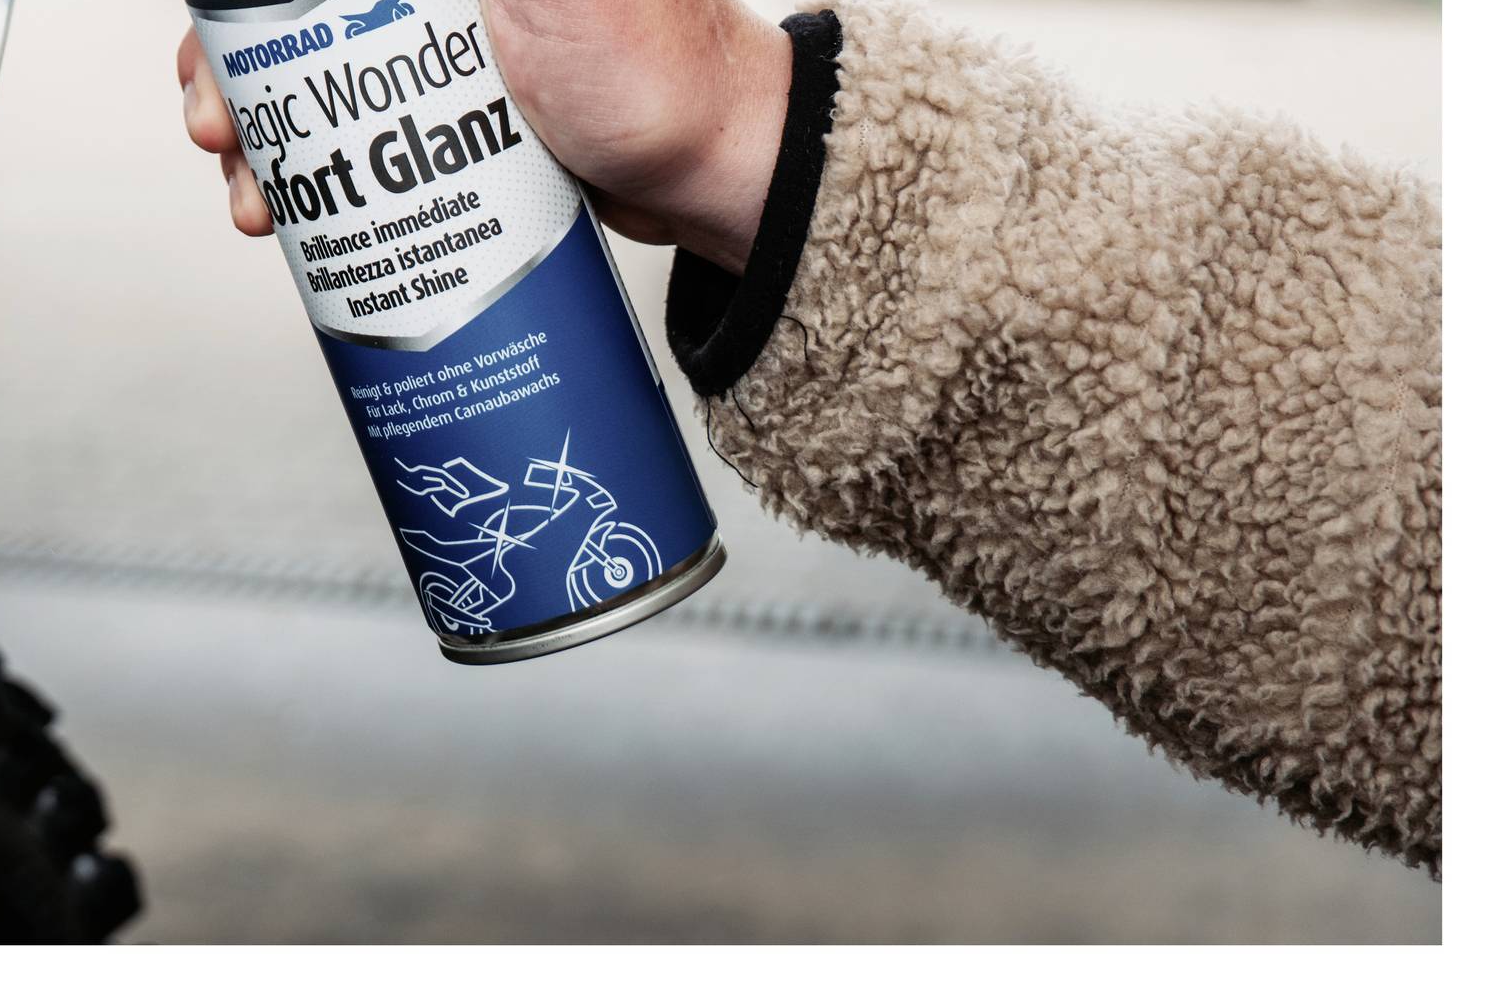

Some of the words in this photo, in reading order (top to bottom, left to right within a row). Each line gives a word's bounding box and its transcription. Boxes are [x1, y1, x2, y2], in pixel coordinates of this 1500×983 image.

[223, 22, 334, 78] MOTORRAD
[304, 21, 487, 126] Wonder
[252, 148, 367, 227] ofort
[369, 96, 523, 194] Glanz
[300, 229, 372, 263] Brilliance
[371, 191, 481, 241] immédiate
[308, 256, 396, 294] Brillantezza
[396, 216, 502, 271] istantanea
[346, 283, 411, 318] Instant
[412, 265, 468, 301] Shine
[350, 383, 382, 402] Reinigt
[383, 382, 393, 395] &
[395, 374, 435, 396] poliert
[437, 361, 473, 382] ohne
[473, 331, 547, 370] Vorwäsche
[366, 405, 382, 419] Für
[382, 400, 411, 418] Lack,
[412, 387, 455, 411] Chrom
[456, 383, 467, 398] &
[470, 354, 541, 394] Kunststoff
[367, 424, 383, 438] Mit
[383, 411, 454, 440] pflegendem
[454, 371, 561, 420] Carnaubawachs
